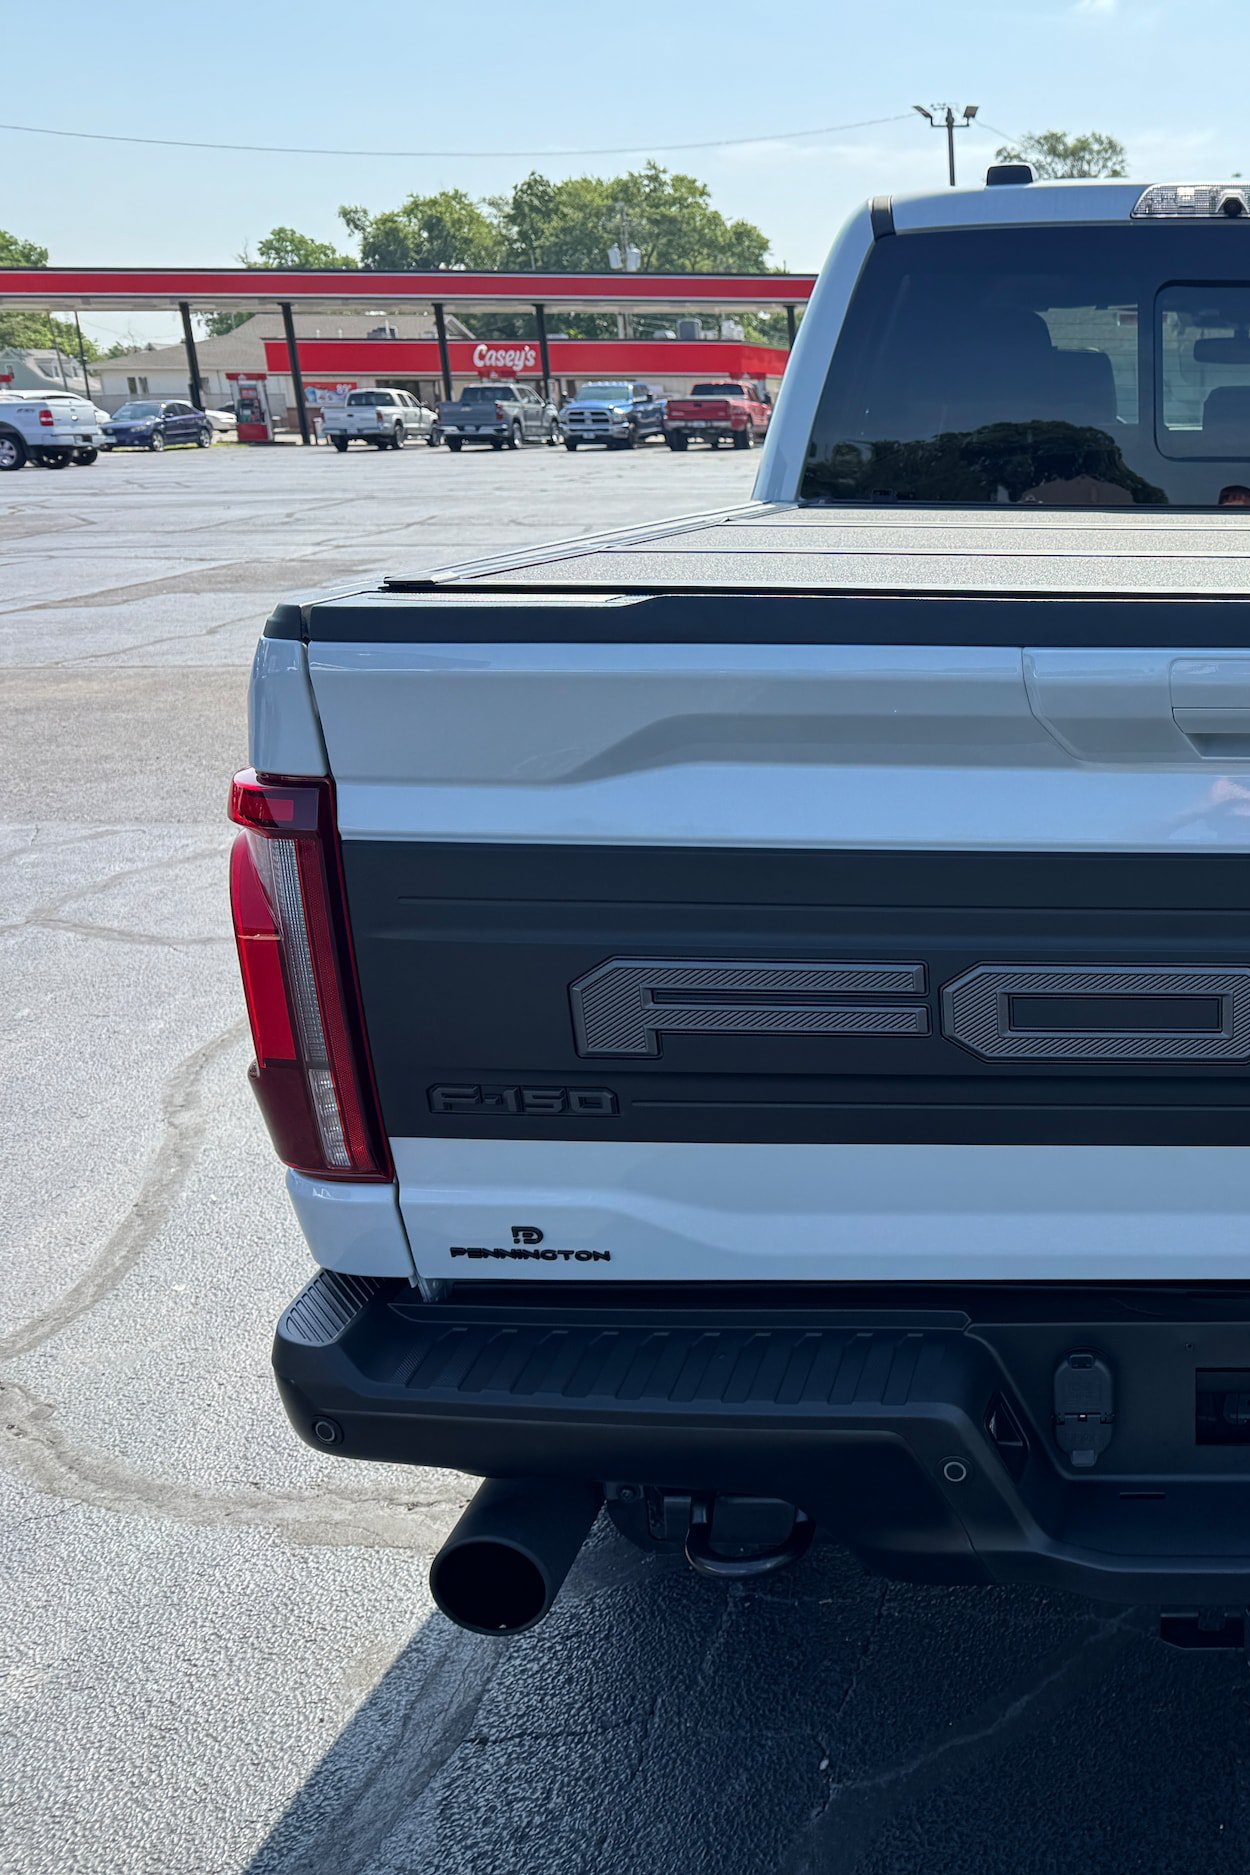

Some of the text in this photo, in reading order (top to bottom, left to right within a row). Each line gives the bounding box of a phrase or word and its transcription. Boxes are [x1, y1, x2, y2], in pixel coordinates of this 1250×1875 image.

[473, 344, 536, 371] Casey's
[428, 1084, 620, 1116] F-150
[450, 1247, 611, 1261] PENNINGTON
